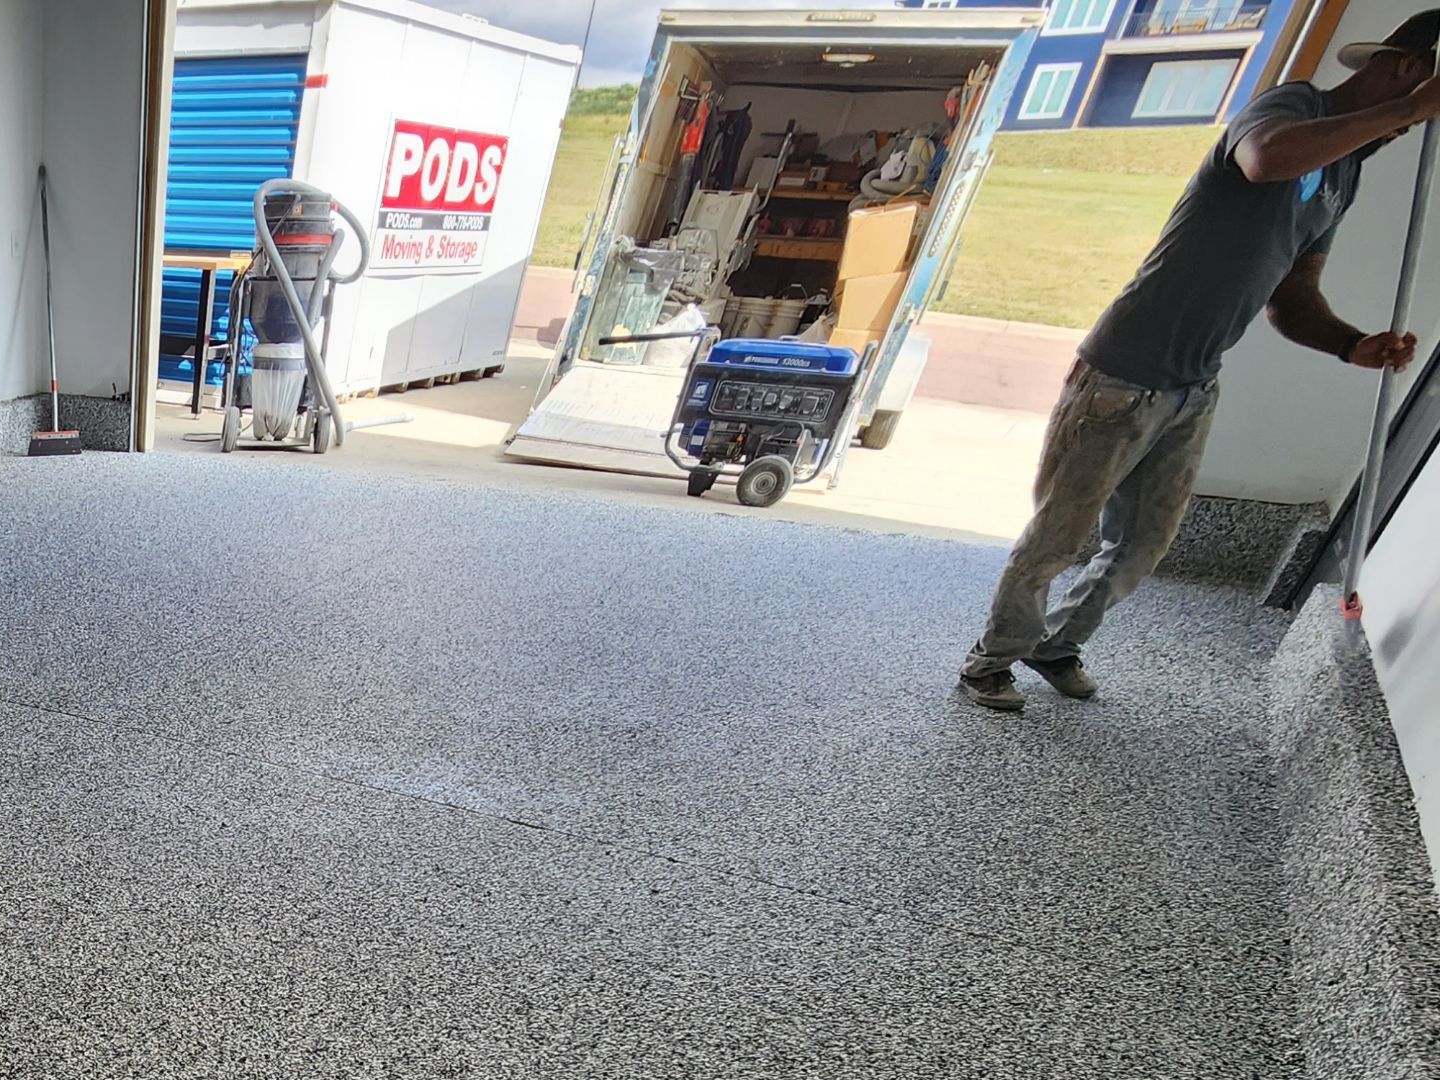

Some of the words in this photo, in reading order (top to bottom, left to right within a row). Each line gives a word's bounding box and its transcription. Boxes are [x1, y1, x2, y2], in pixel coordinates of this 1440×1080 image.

[386, 131, 503, 205] PODS
[385, 212, 423, 230] PODS.com
[380, 233, 424, 264] Moving
[425, 234, 435, 259] &
[436, 235, 478, 264] Storage
